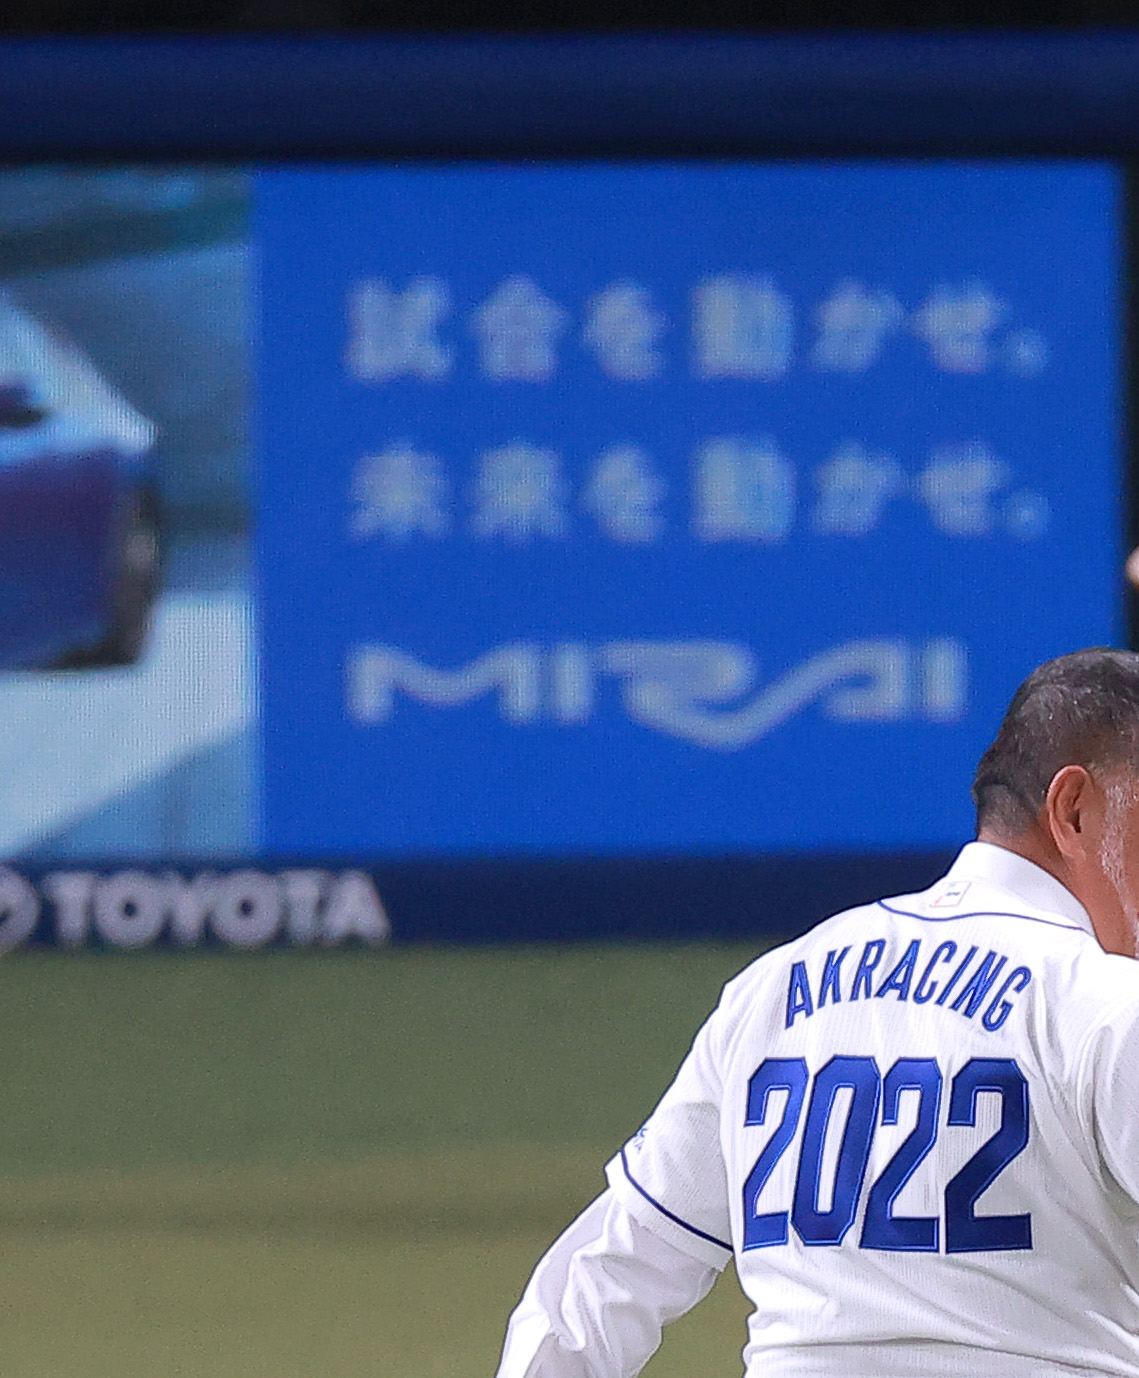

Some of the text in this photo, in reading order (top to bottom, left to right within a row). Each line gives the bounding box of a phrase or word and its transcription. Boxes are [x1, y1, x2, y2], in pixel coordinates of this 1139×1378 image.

[346, 637, 970, 750] MIRAI
[42, 868, 391, 949] TOYOTA
[785, 938, 1032, 1032] AKRACING
[742, 1054, 1034, 1254] 2022
